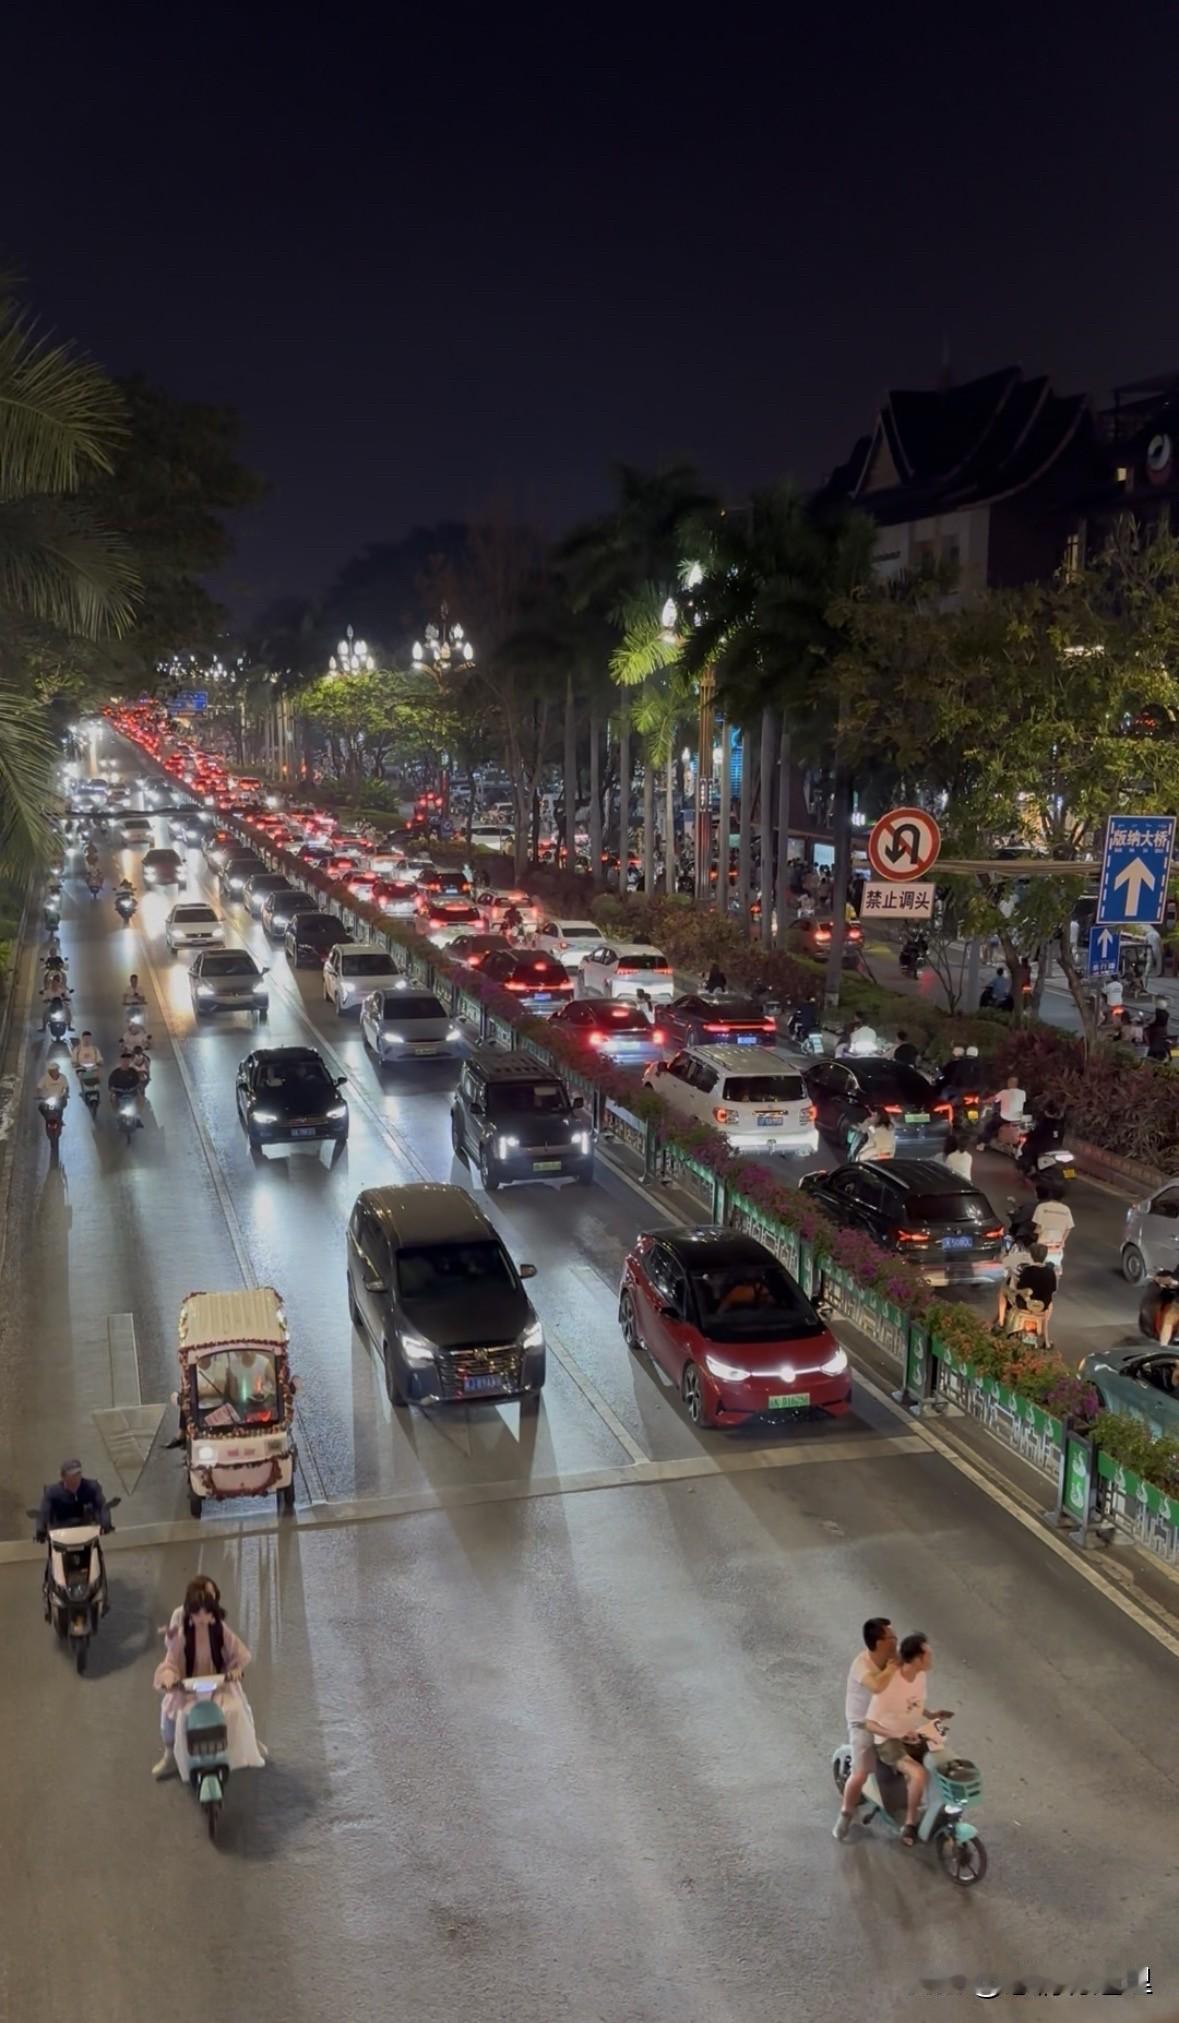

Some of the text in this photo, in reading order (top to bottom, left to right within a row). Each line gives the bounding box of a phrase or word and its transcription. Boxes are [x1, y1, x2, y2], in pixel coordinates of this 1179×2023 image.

[1112, 829, 1168, 848] 版纳大桥
[866, 890, 930, 910] 禁止调头
